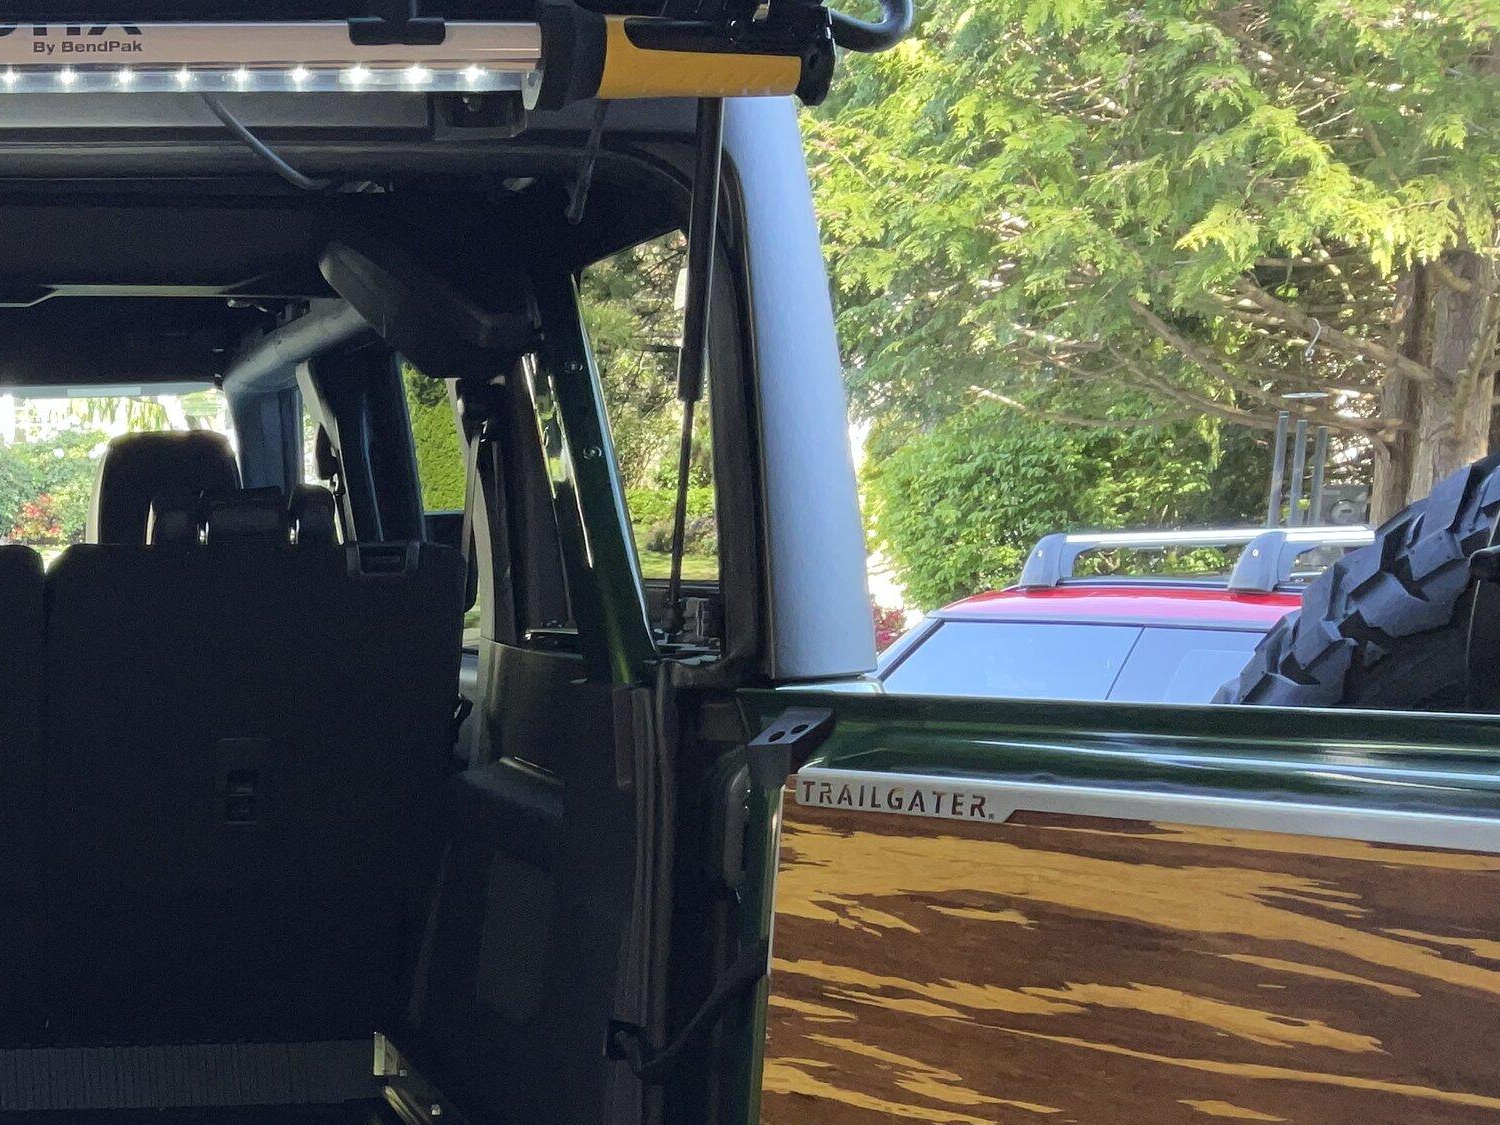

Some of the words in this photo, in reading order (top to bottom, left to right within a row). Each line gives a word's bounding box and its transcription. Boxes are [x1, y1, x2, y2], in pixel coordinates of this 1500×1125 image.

[33, 41, 55, 55] By
[61, 40, 143, 53] BendPak
[802, 780, 987, 818] TRAILGATER
